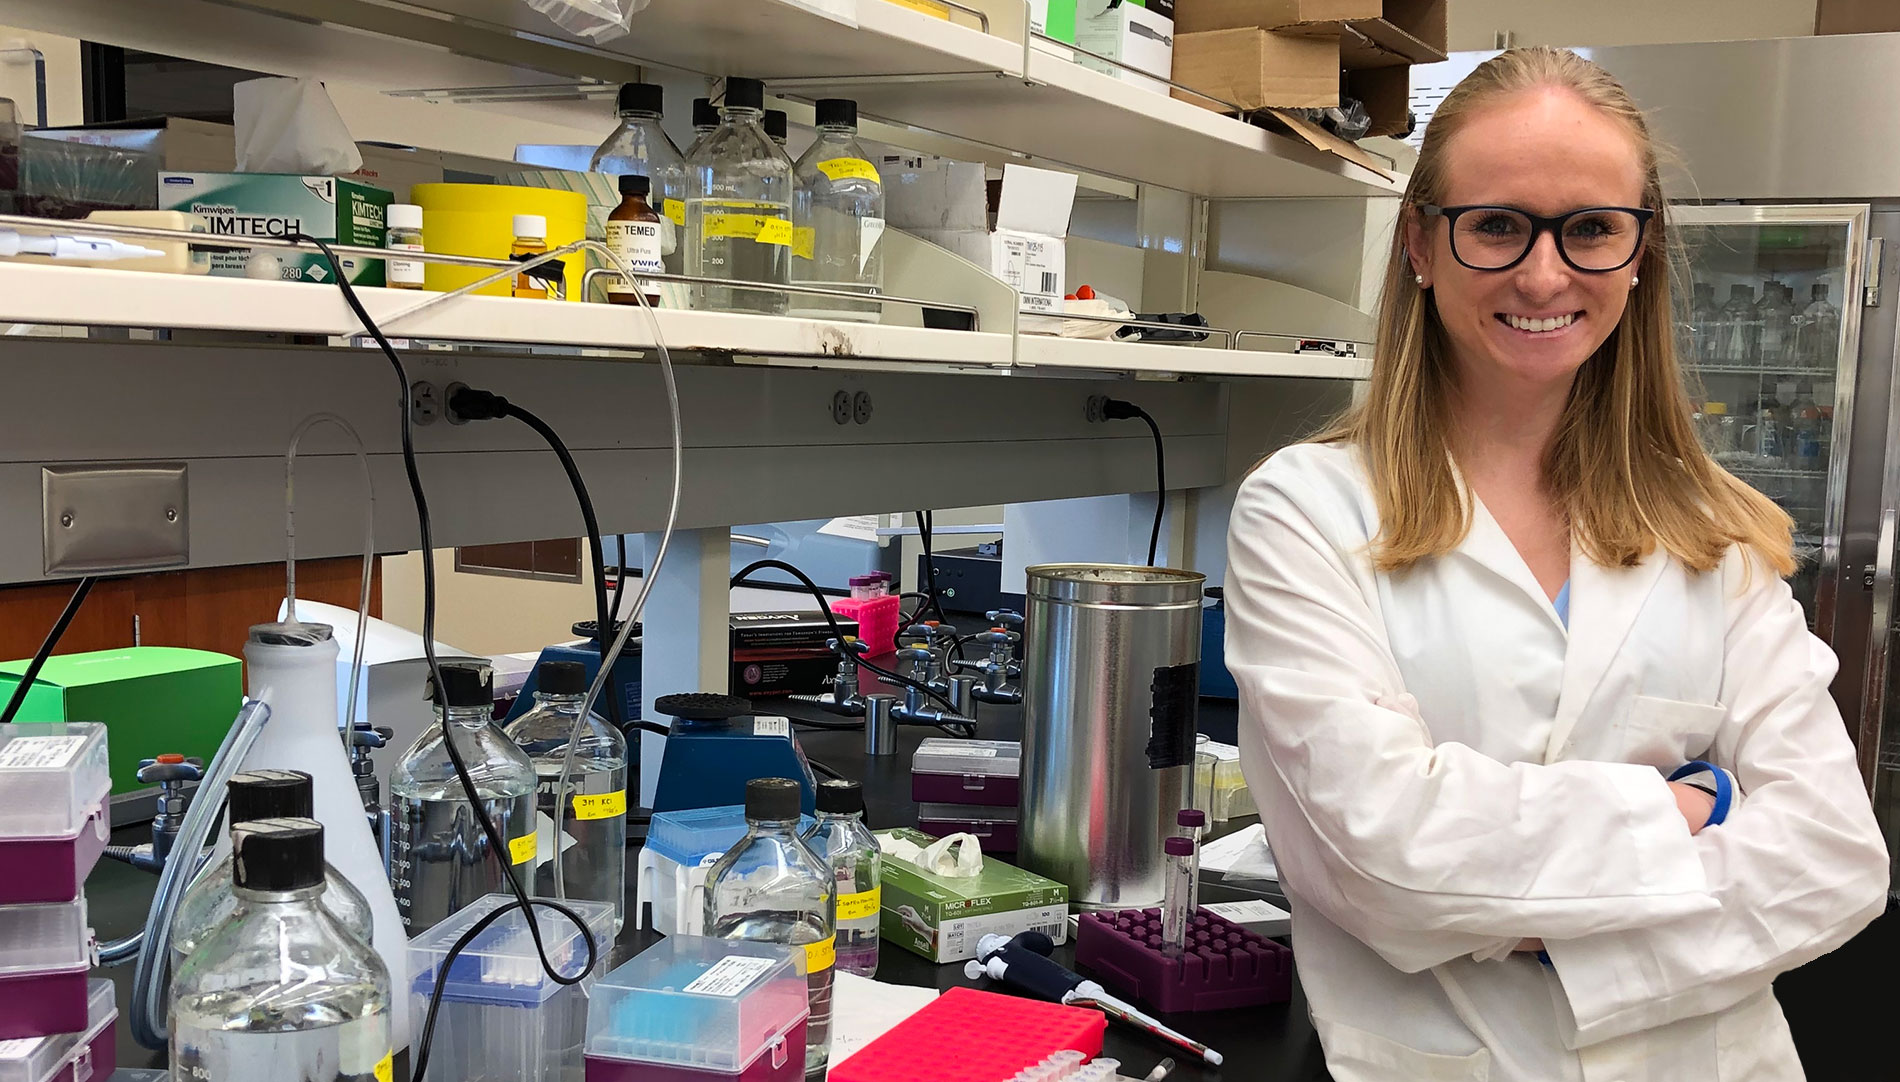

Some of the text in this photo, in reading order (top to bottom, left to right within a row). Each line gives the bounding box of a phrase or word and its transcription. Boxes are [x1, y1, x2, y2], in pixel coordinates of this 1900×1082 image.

[326, 180, 331, 197] 1
[193, 205, 235, 215] Kimwipes
[352, 200, 383, 221] KIMTECH
[203, 216, 300, 236] IMTECH
[624, 225, 656, 237] TEMED
[711, 257, 724, 265] 200
[282, 268, 302, 279] 280
[399, 840, 410, 850] 700
[399, 859, 410, 869] 600
[400, 878, 410, 888] 500
[1054, 888, 1060, 896] M
[400, 897, 410, 907] 400
[945, 897, 991, 910] MICROFLEX
[192, 1066, 212, 1080] 800
